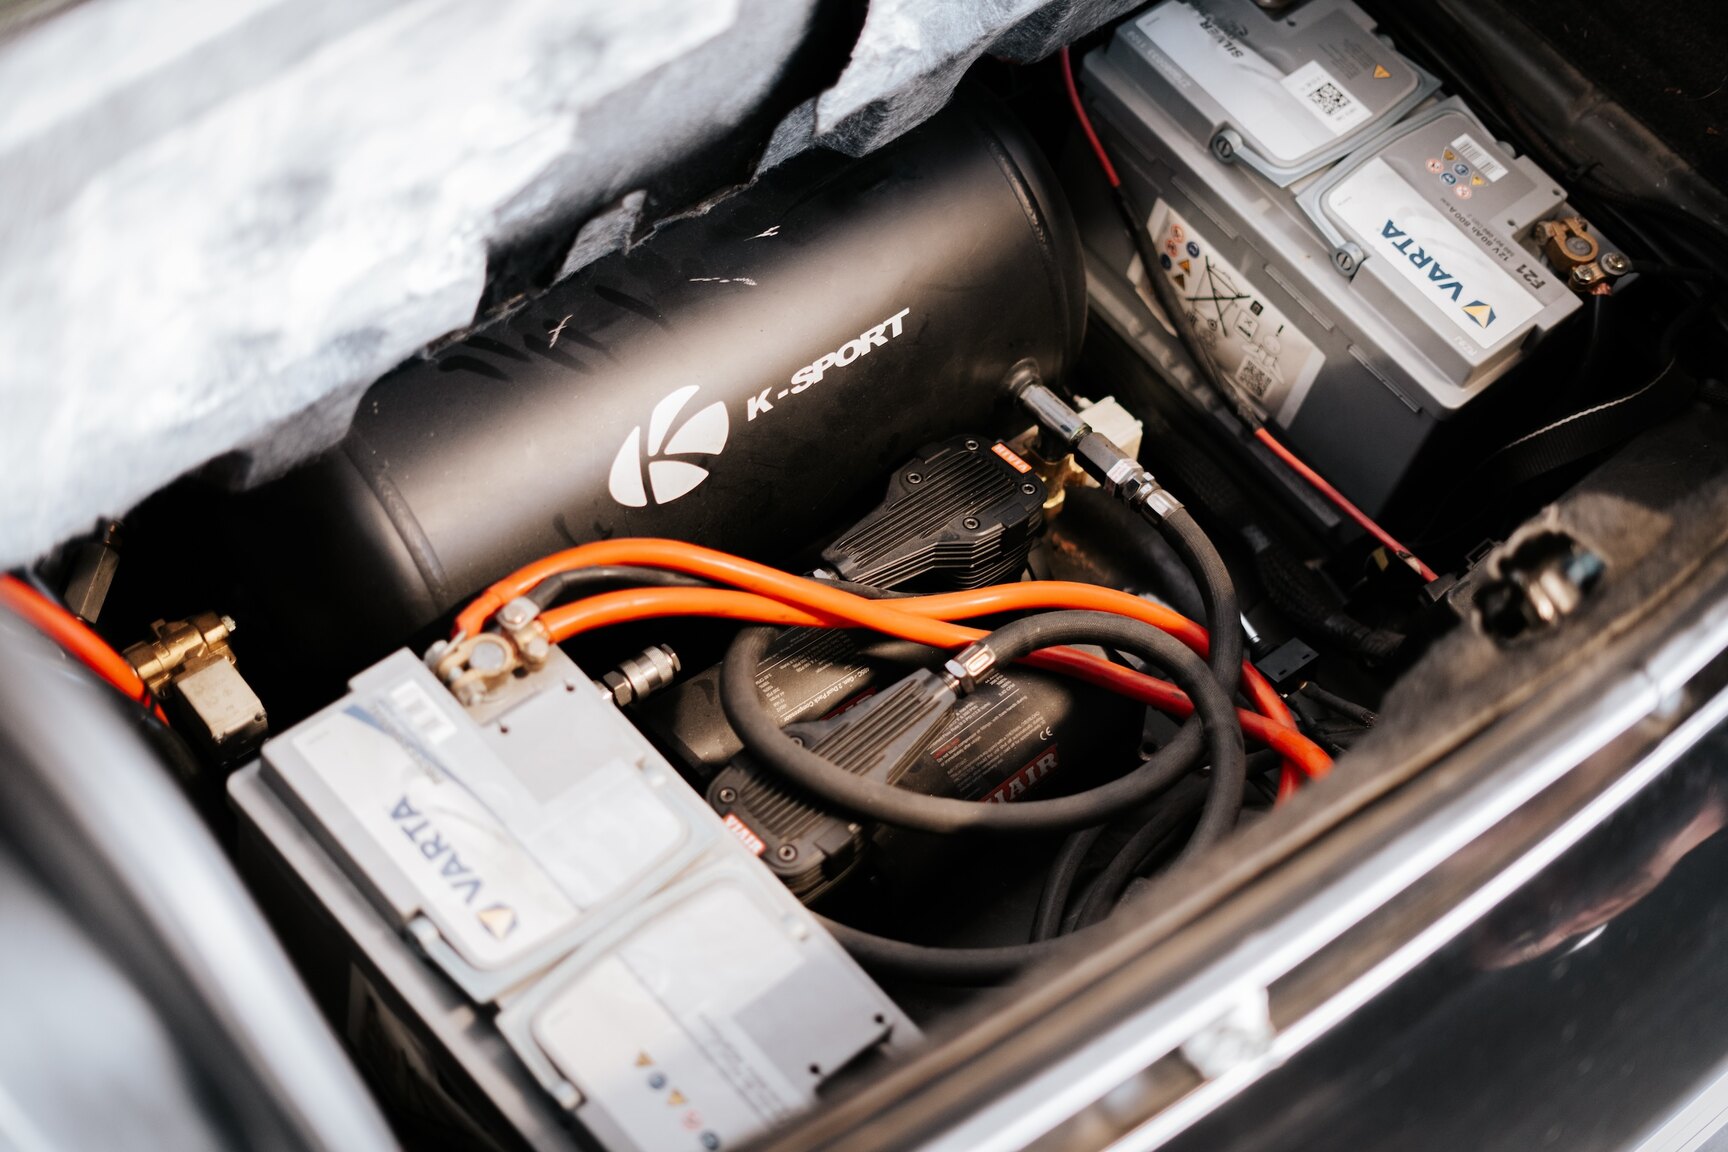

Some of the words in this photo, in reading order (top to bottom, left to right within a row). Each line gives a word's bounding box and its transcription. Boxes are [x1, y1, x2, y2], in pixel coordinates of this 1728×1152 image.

[1199, 20, 1244, 59] SILVER
[1380, 218, 1462, 302] VARTA
[1515, 263, 1546, 290] F21
[748, 307, 910, 421] K-SPORT
[813, 693, 827, 704] Pack
[826, 685, 839, 697] Dual
[783, 700, 814, 722] Compressor
[1038, 726, 1054, 742] CE
[985, 752, 1059, 803] IAIR
[389, 795, 486, 905] VARTA
